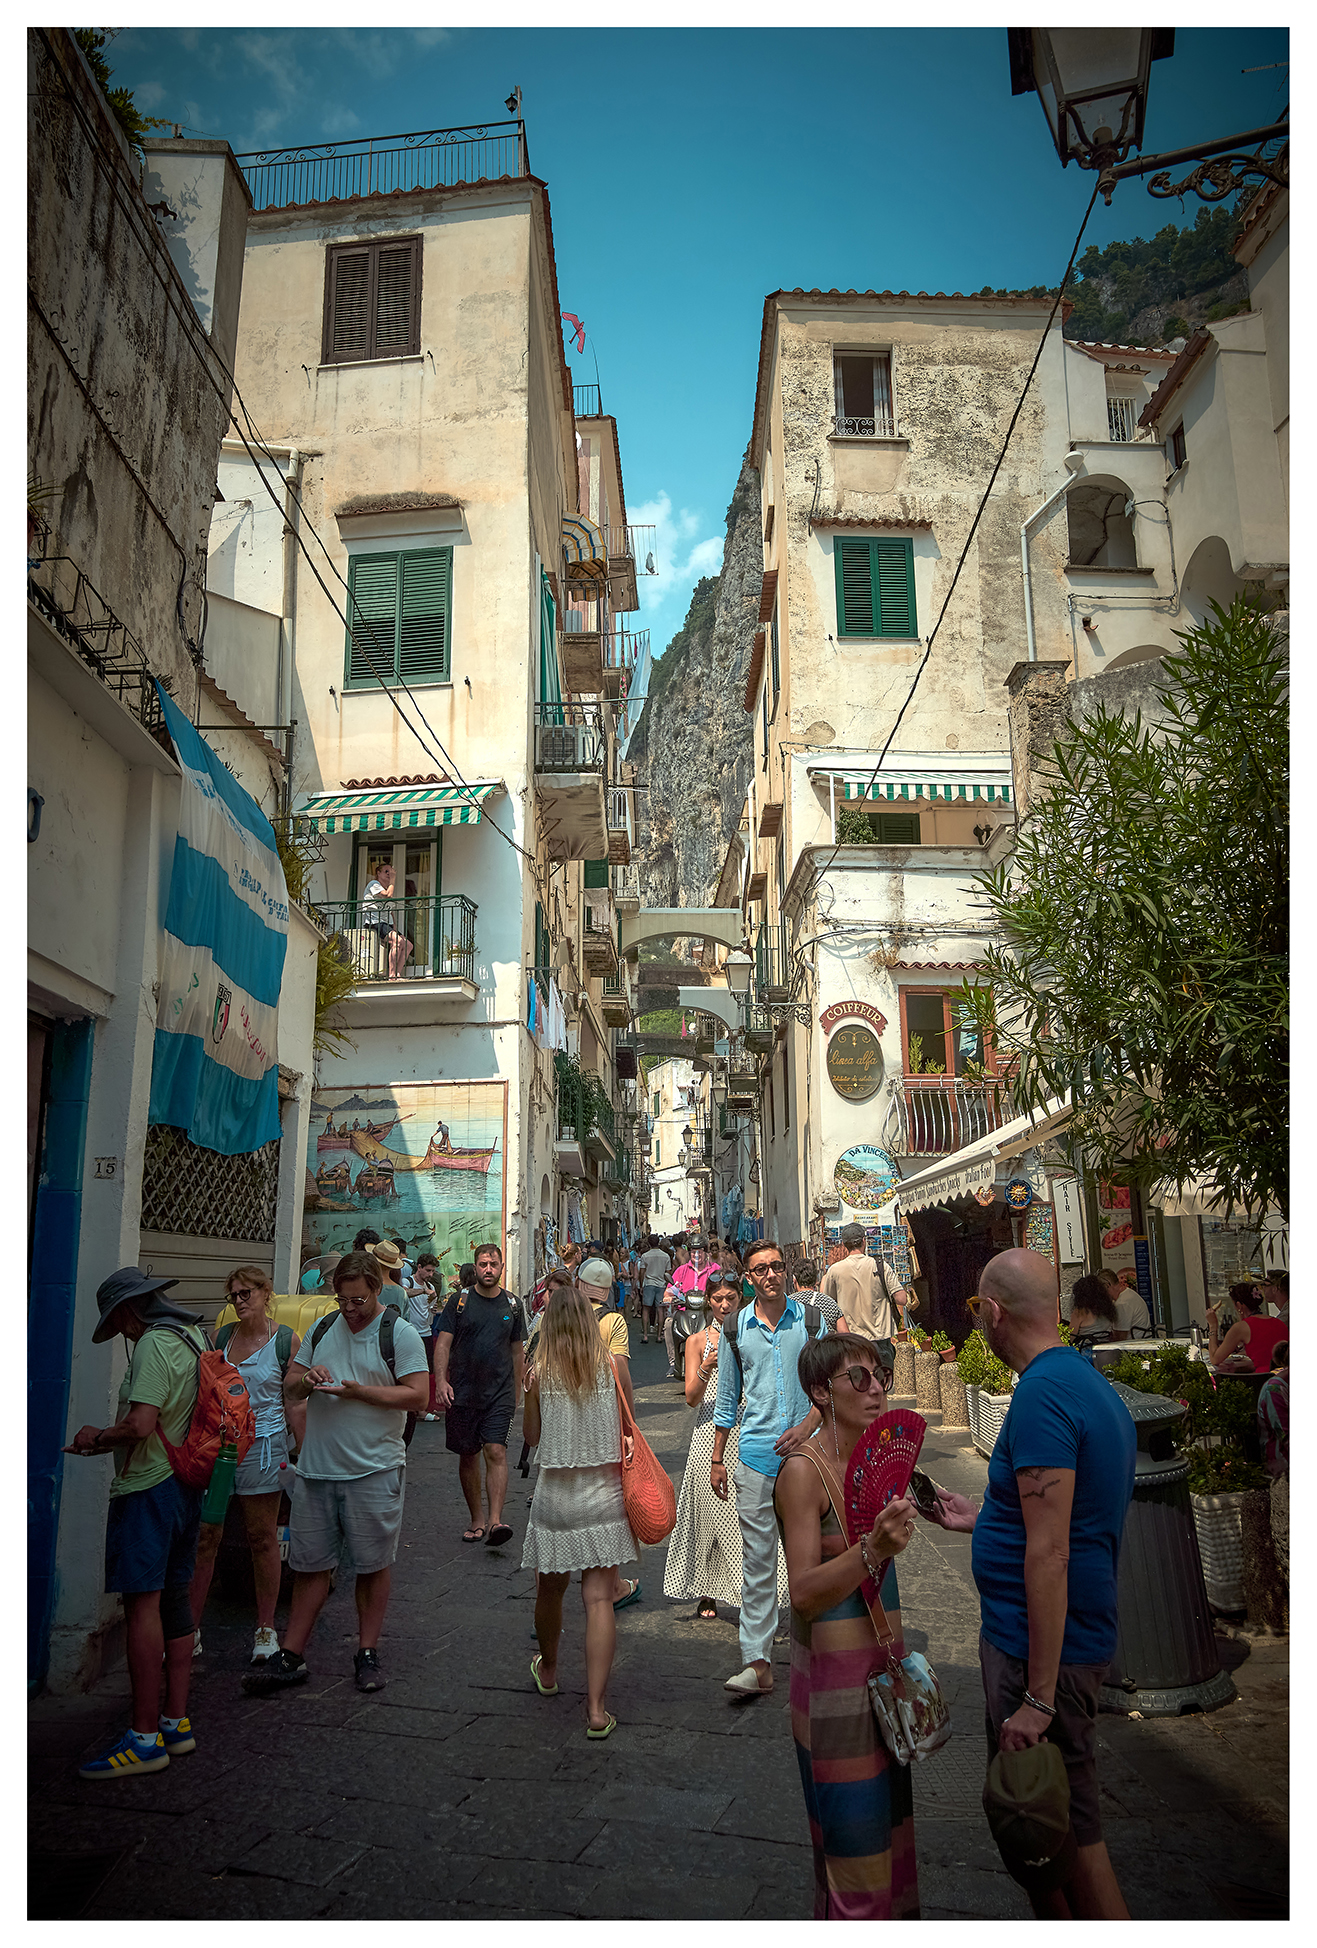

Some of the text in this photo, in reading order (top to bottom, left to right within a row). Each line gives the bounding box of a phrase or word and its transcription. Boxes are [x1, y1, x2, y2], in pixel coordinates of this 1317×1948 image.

[826, 1002, 882, 1025] COIFFEUR
[848, 1147, 861, 1157] DA
[96, 1162, 116, 1175] 15
[981, 1161, 992, 1180] Food
[1062, 1184, 1075, 1258] HAIR STYLE
